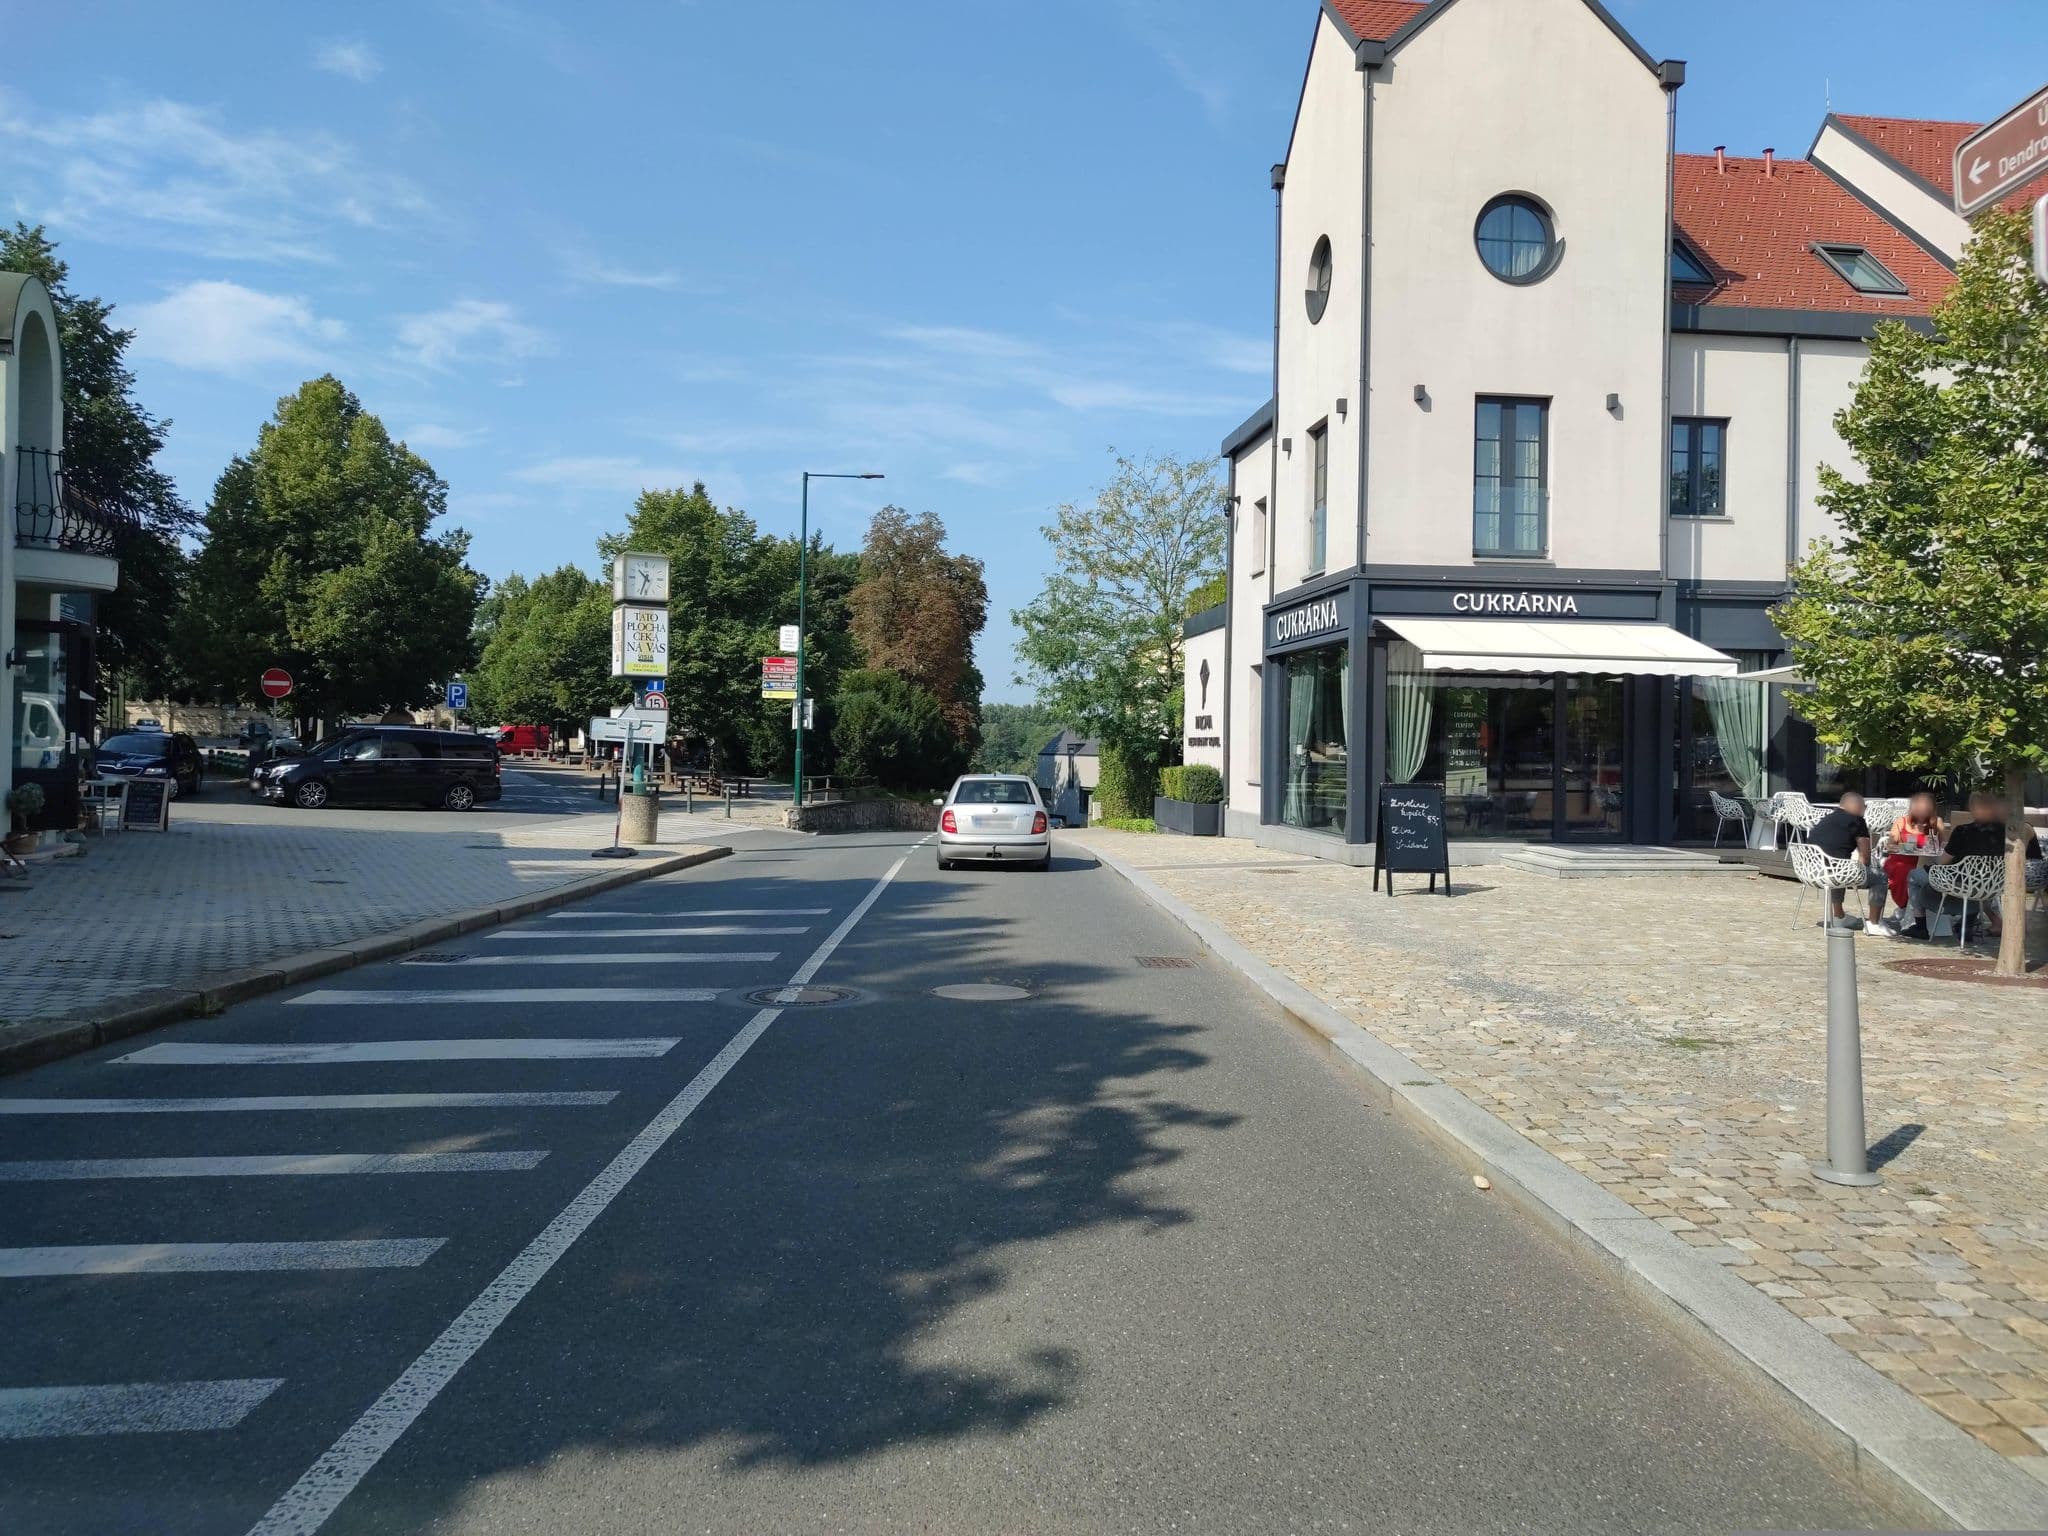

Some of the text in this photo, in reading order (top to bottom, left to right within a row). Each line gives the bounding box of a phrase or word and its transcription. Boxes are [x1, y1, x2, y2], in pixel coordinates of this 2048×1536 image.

[1453, 592, 1578, 613] CUKRÁRNA
[634, 612, 659, 622] TATO
[1276, 599, 1339, 641] CUKRÁRNA
[627, 622, 666, 633] PLOCHA
[626, 641, 643, 653] NA
[451, 686, 463, 702] P
[649, 698, 661, 709] 15
